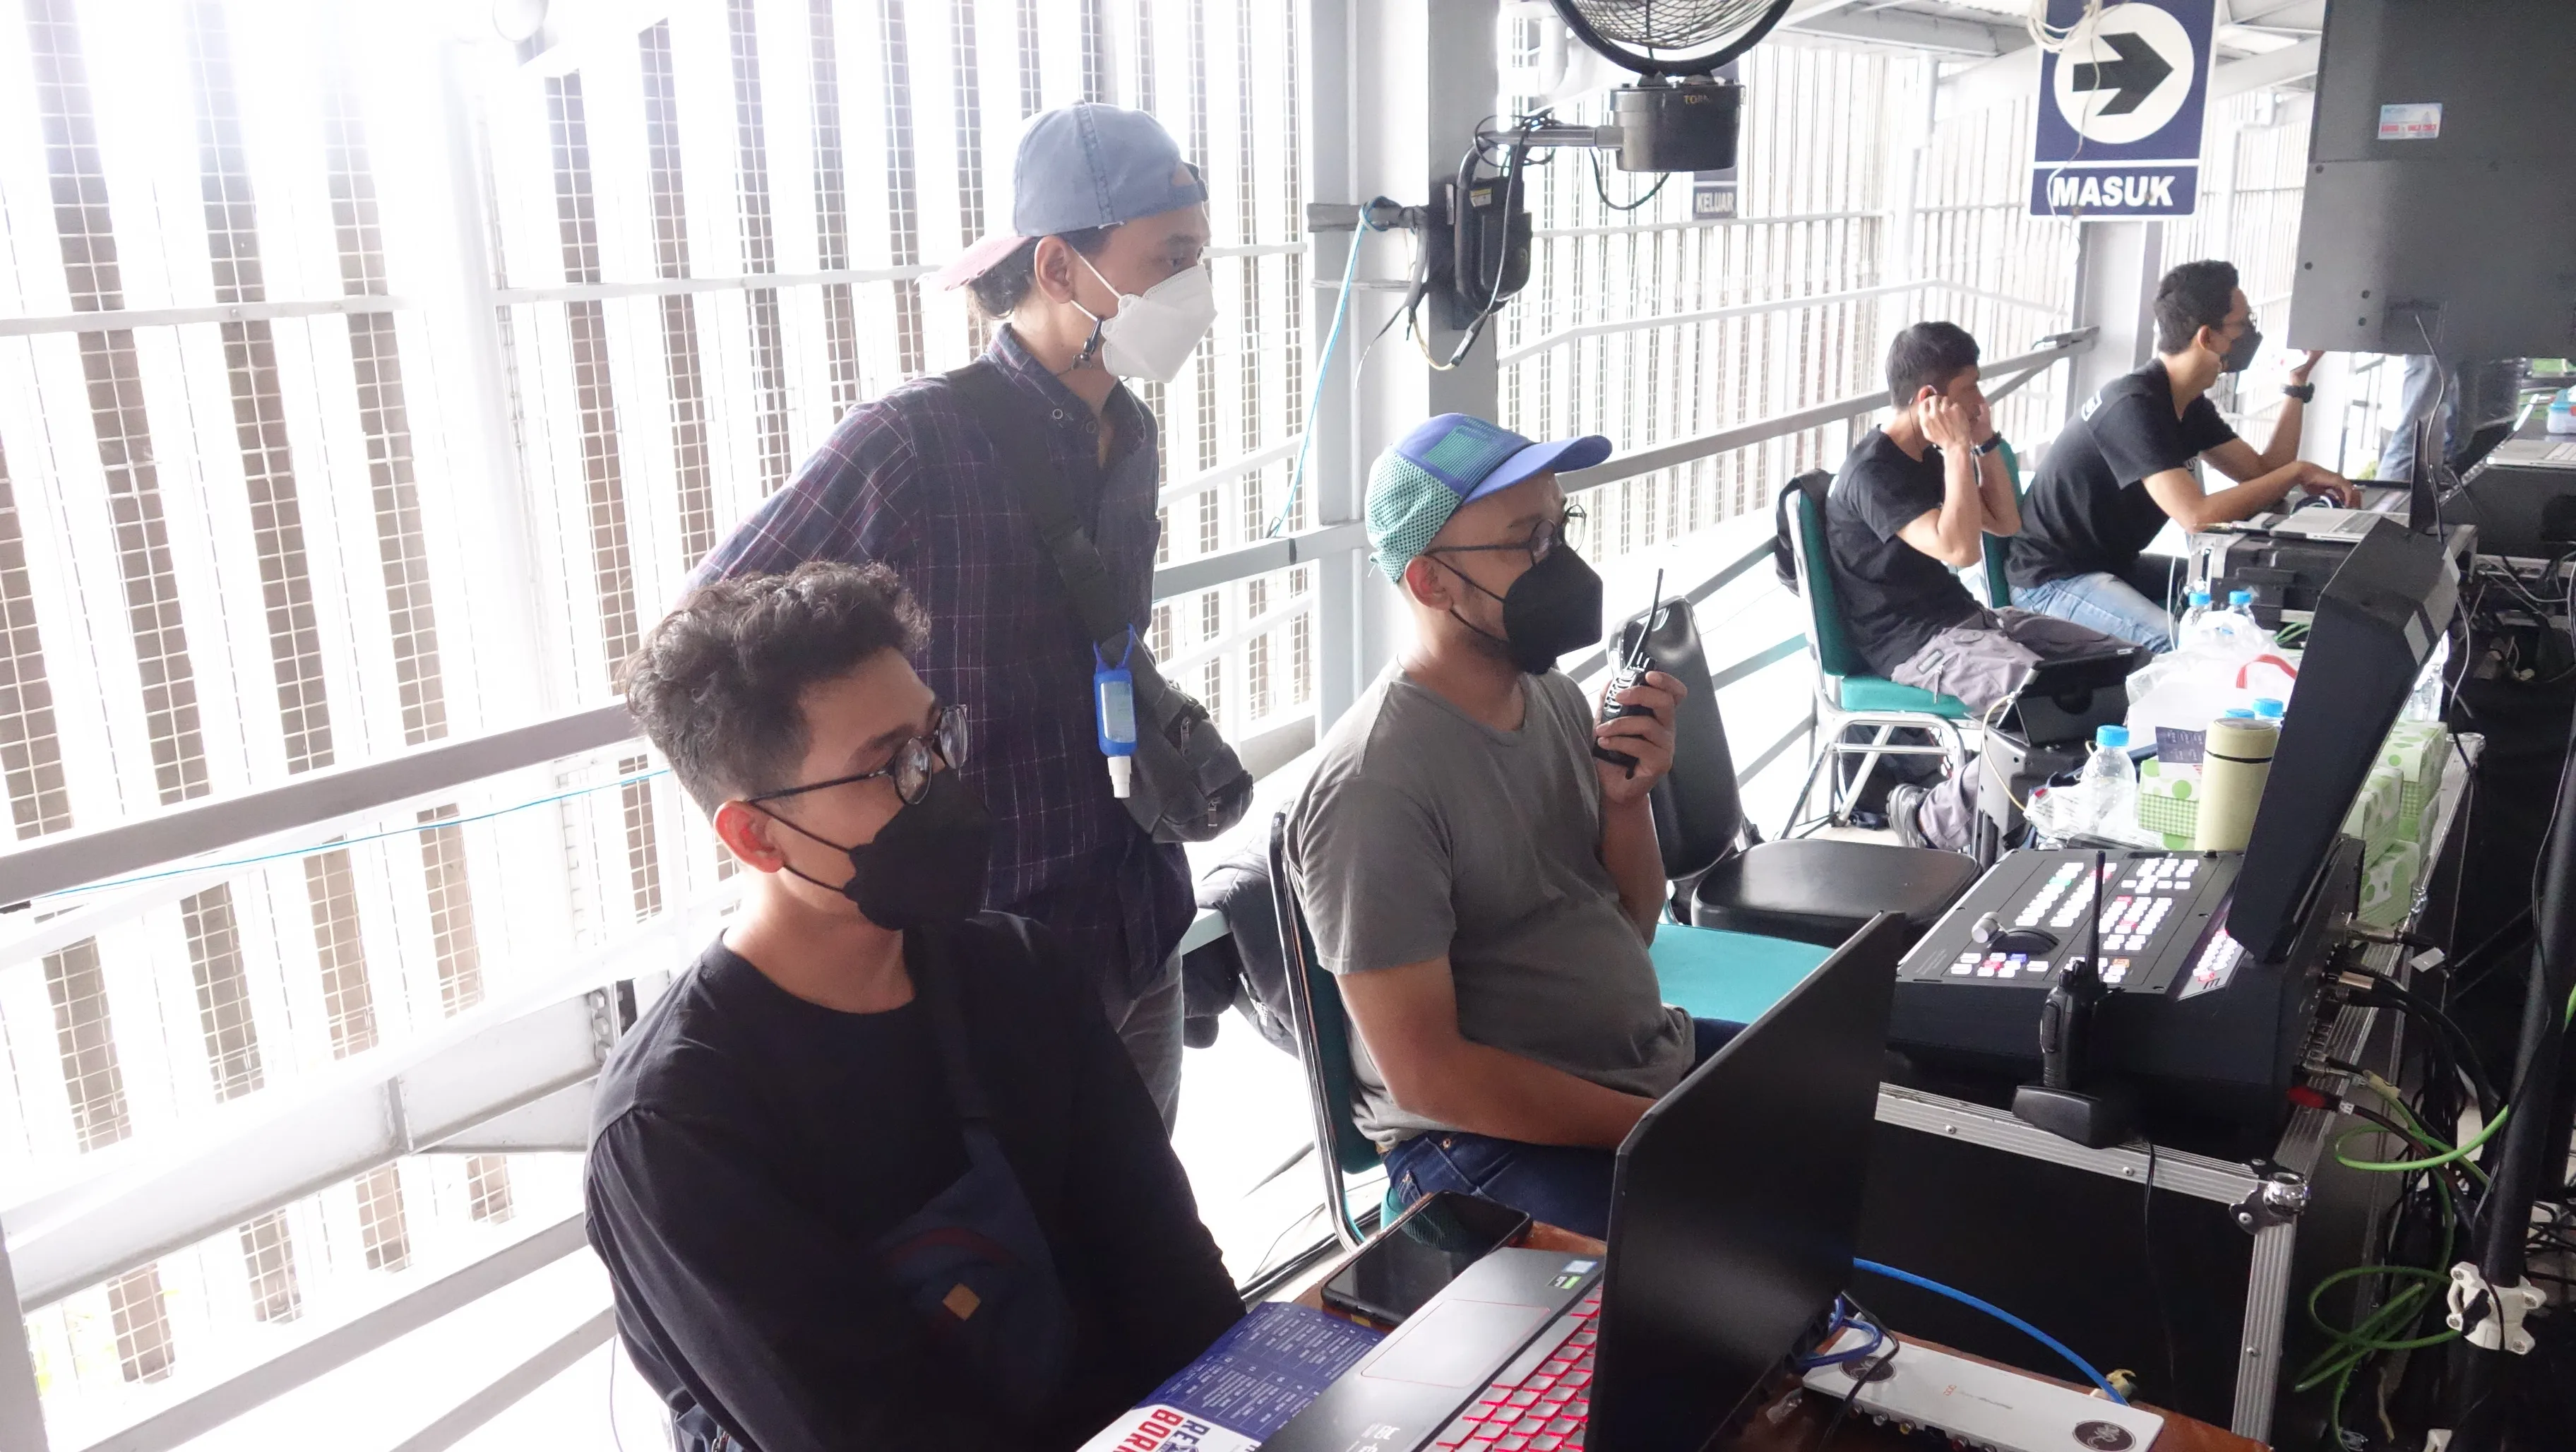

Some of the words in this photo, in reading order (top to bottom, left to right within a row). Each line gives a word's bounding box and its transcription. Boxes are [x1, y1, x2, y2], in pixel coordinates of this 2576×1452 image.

[1696, 191, 1734, 213] KELUAR
[2052, 176, 2176, 207] MASUK
[1173, 1419, 1211, 1445] RE
